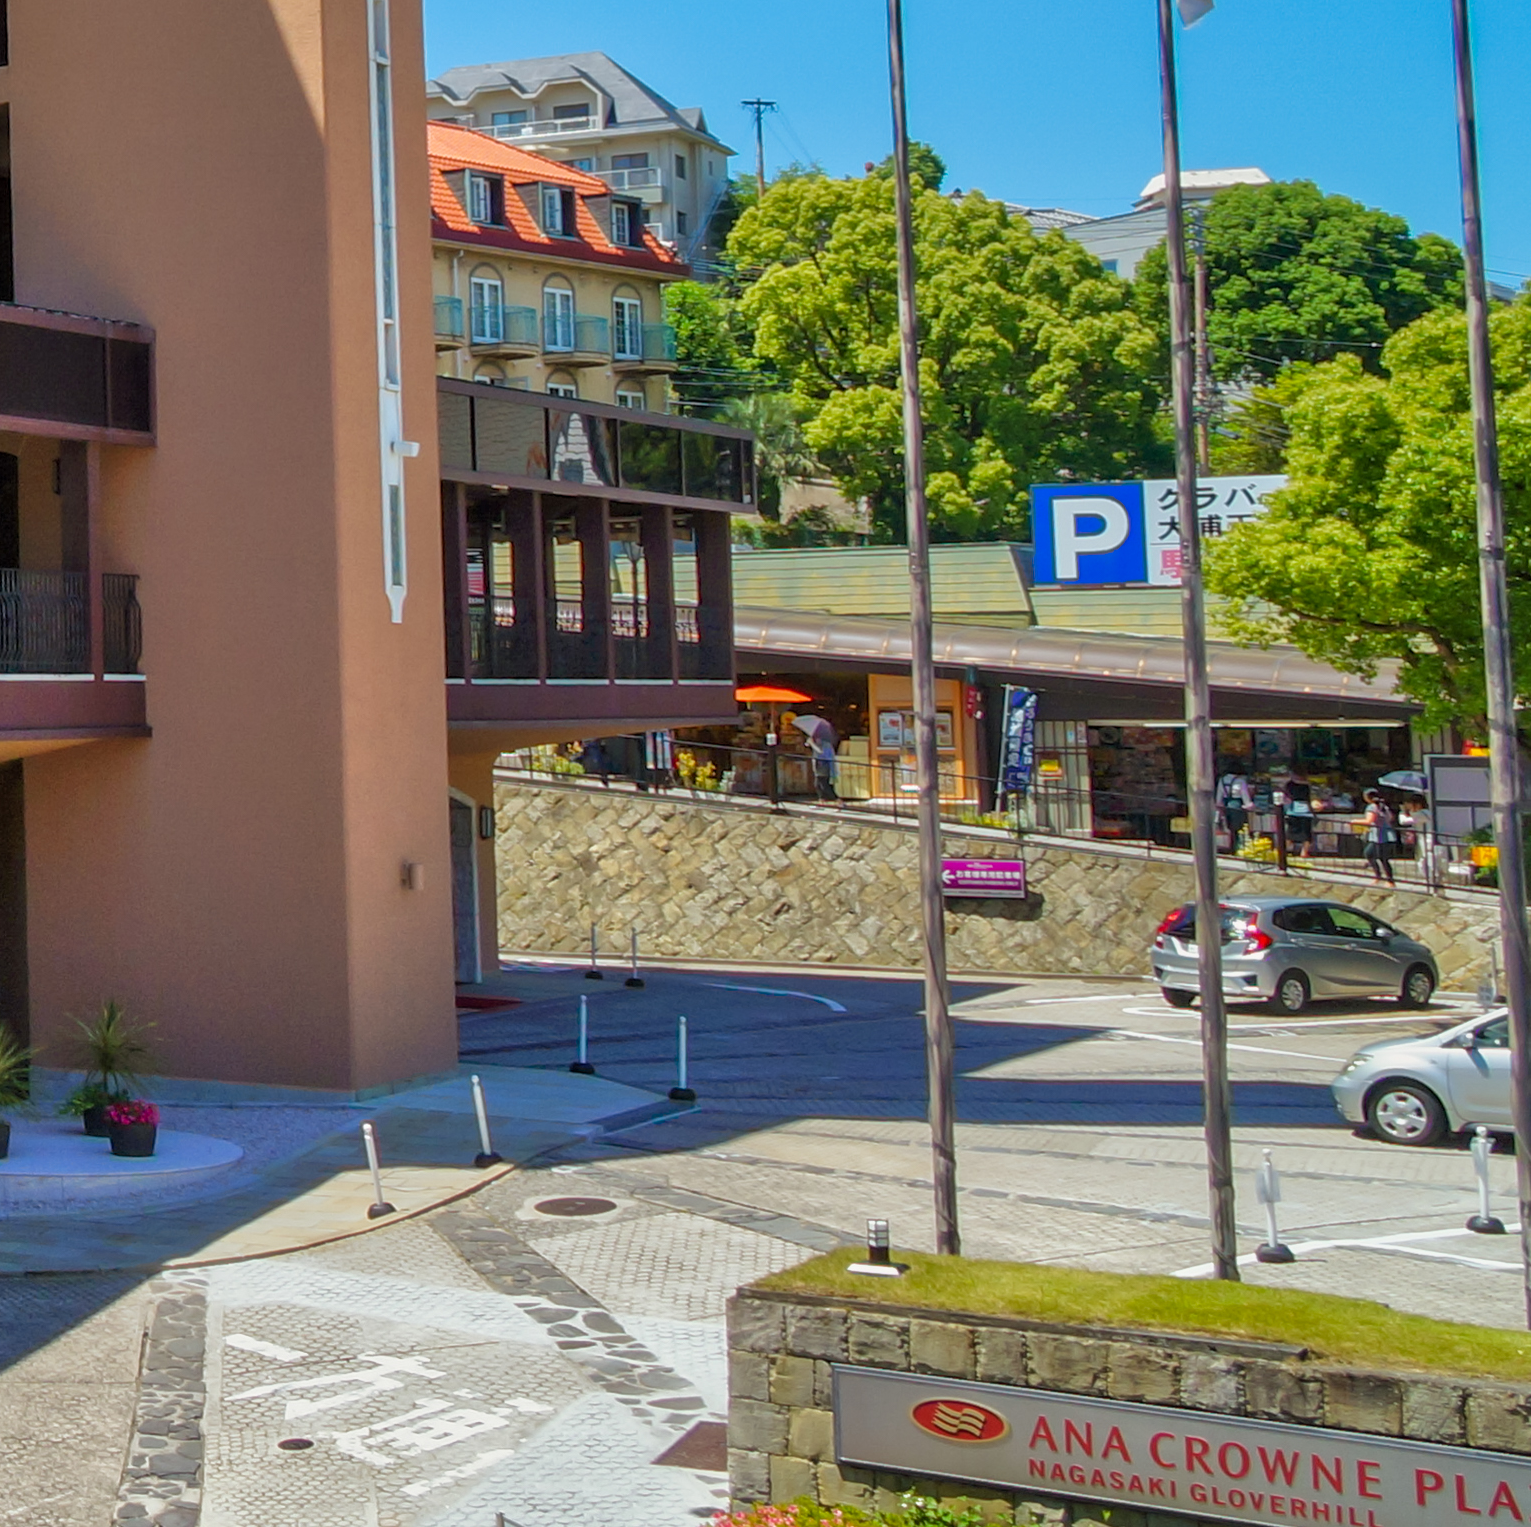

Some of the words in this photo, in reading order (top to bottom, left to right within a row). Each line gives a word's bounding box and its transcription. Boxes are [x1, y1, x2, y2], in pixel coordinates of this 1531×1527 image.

[1052, 496, 1130, 581] P
[1028, 1414, 1133, 1464] ANA
[1148, 1431, 1383, 1500] CROWNE
[1413, 1467, 1531, 1523] PLA
[1028, 1458, 1177, 1499] NAGASAKI
[1190, 1482, 1383, 1527] GLOVERHILL
